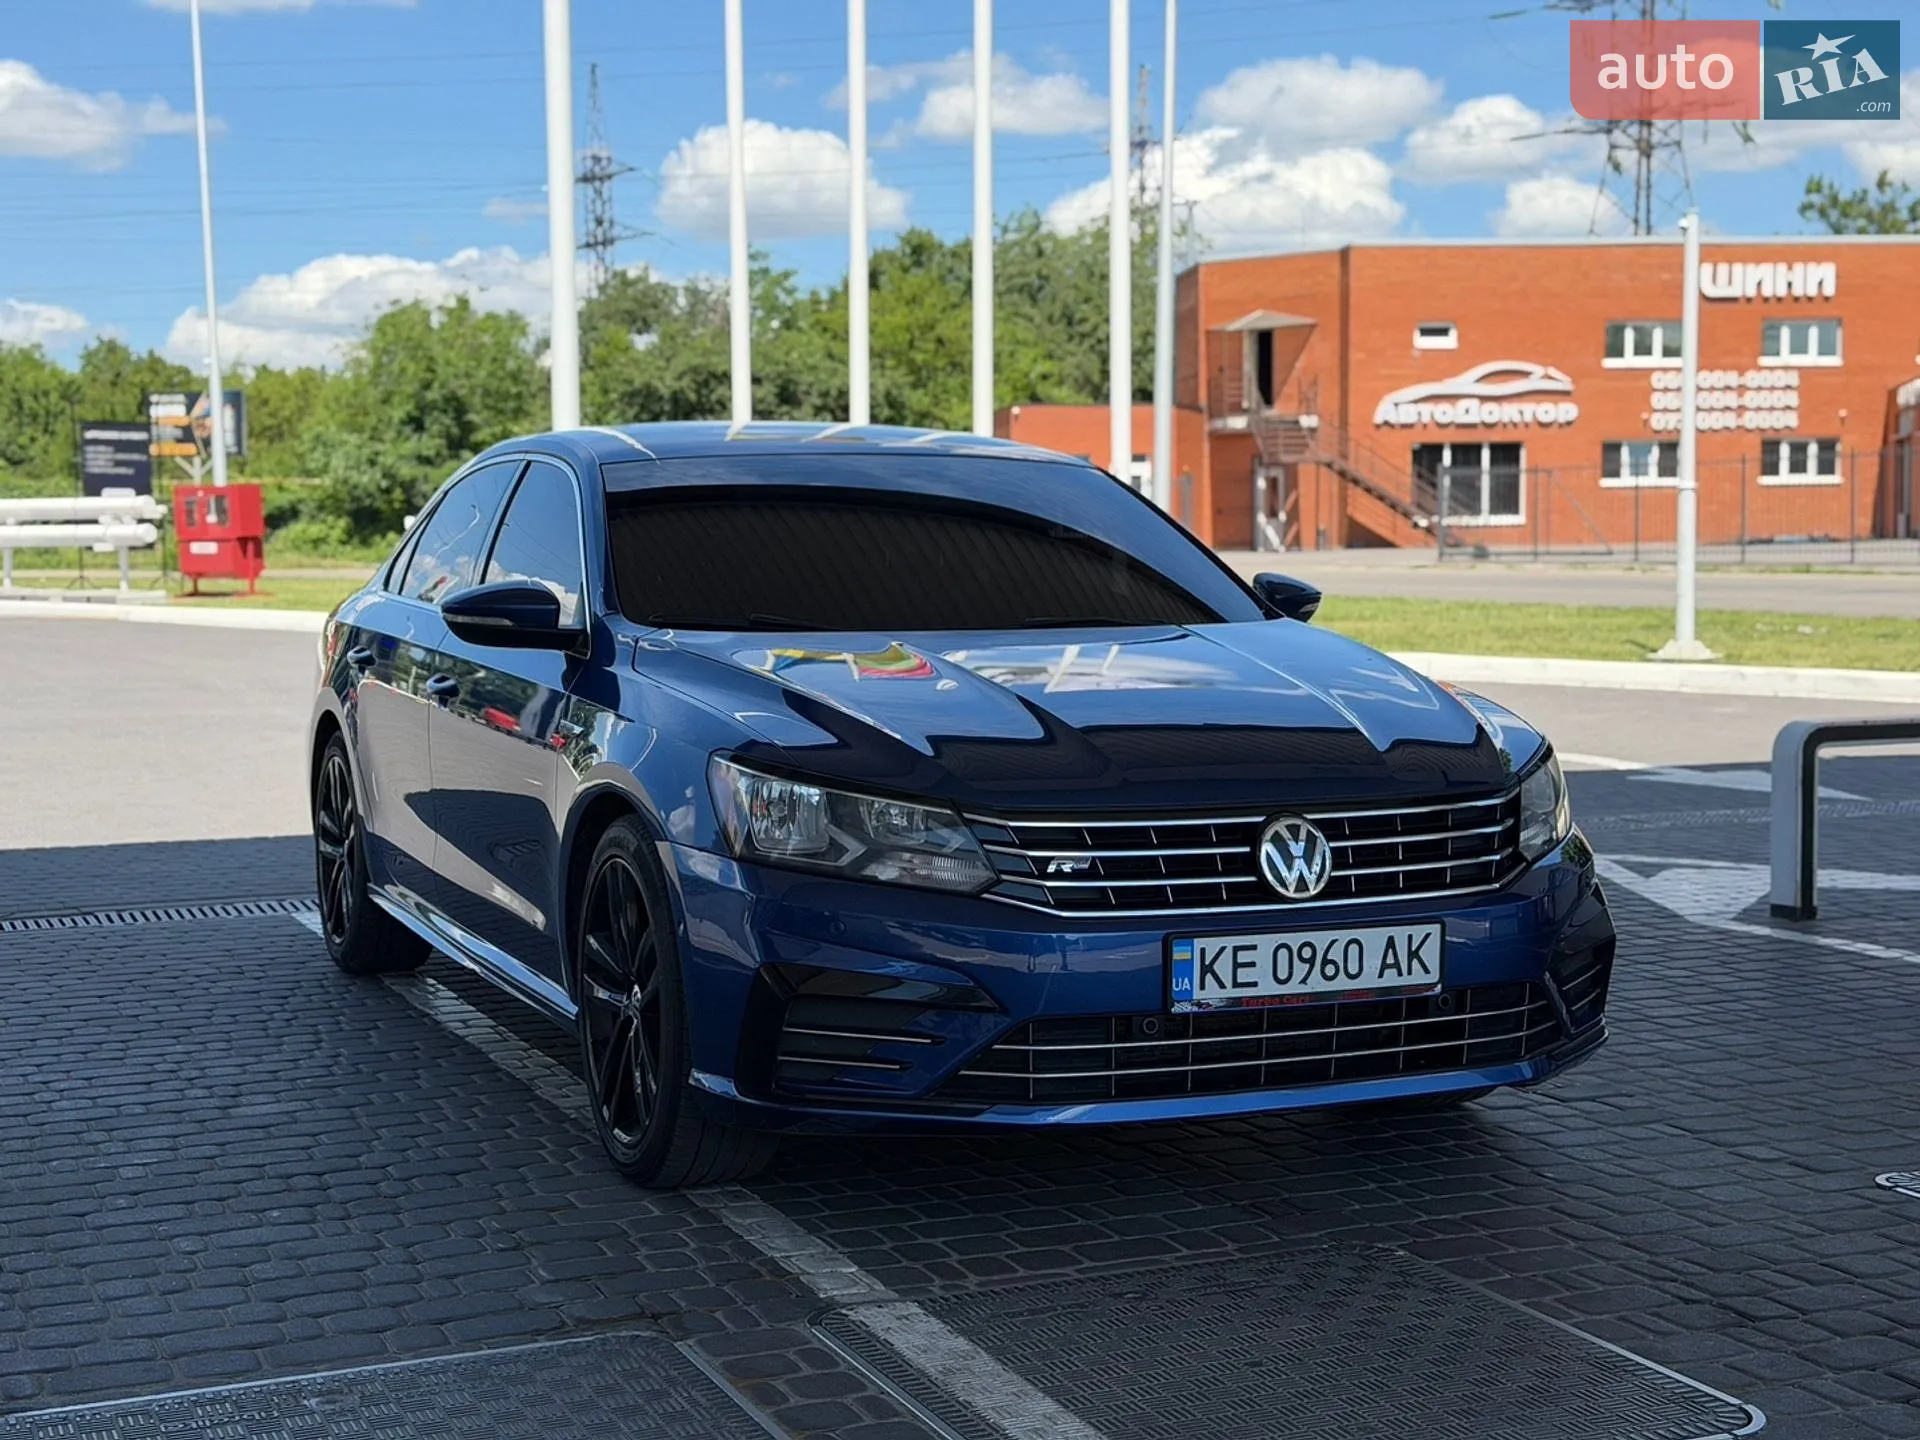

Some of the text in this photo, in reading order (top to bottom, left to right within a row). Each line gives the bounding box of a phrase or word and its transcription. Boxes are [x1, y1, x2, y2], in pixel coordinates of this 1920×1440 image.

[1199, 932, 1433, 991] KE 0960 AK
[1172, 976, 1191, 991] UA
